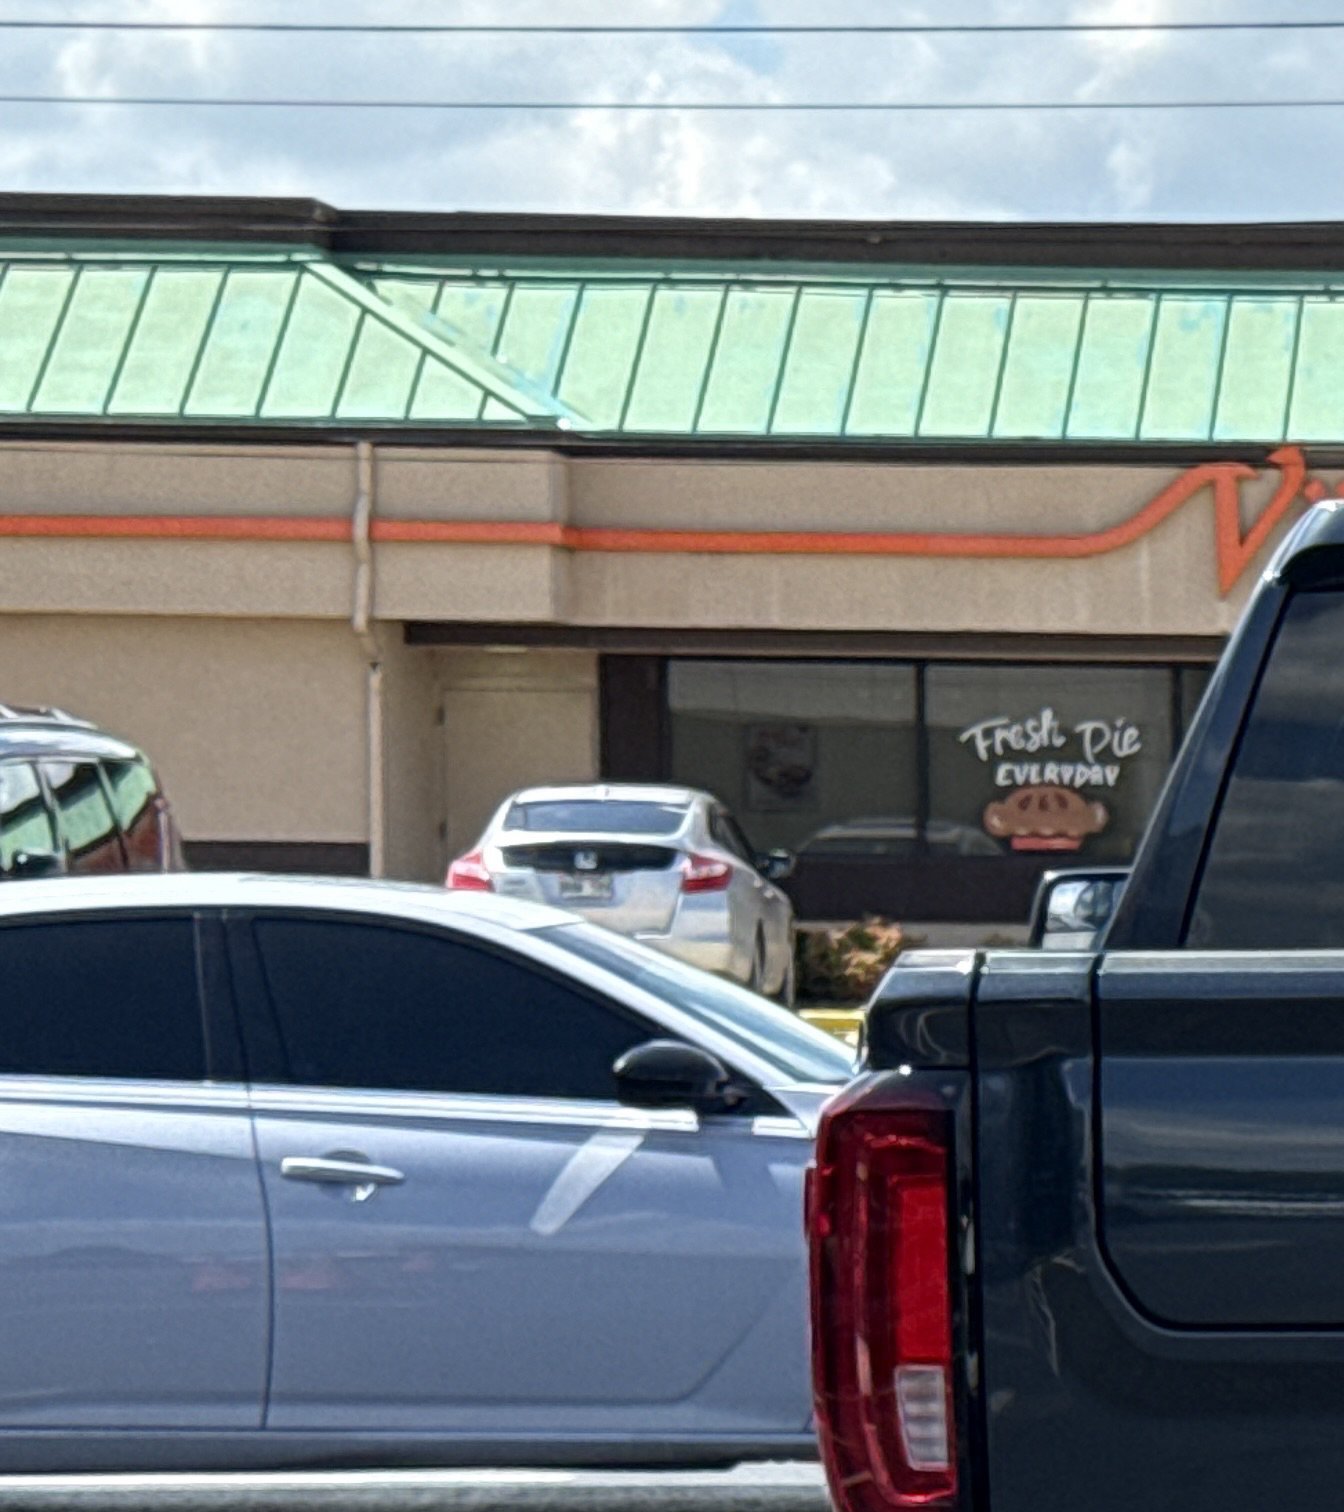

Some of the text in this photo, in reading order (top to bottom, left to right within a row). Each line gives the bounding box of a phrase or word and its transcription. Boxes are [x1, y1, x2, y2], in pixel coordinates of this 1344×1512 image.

[959, 707, 1142, 762] Fresh Pie
[995, 762, 1121, 787] EVERYDAY
